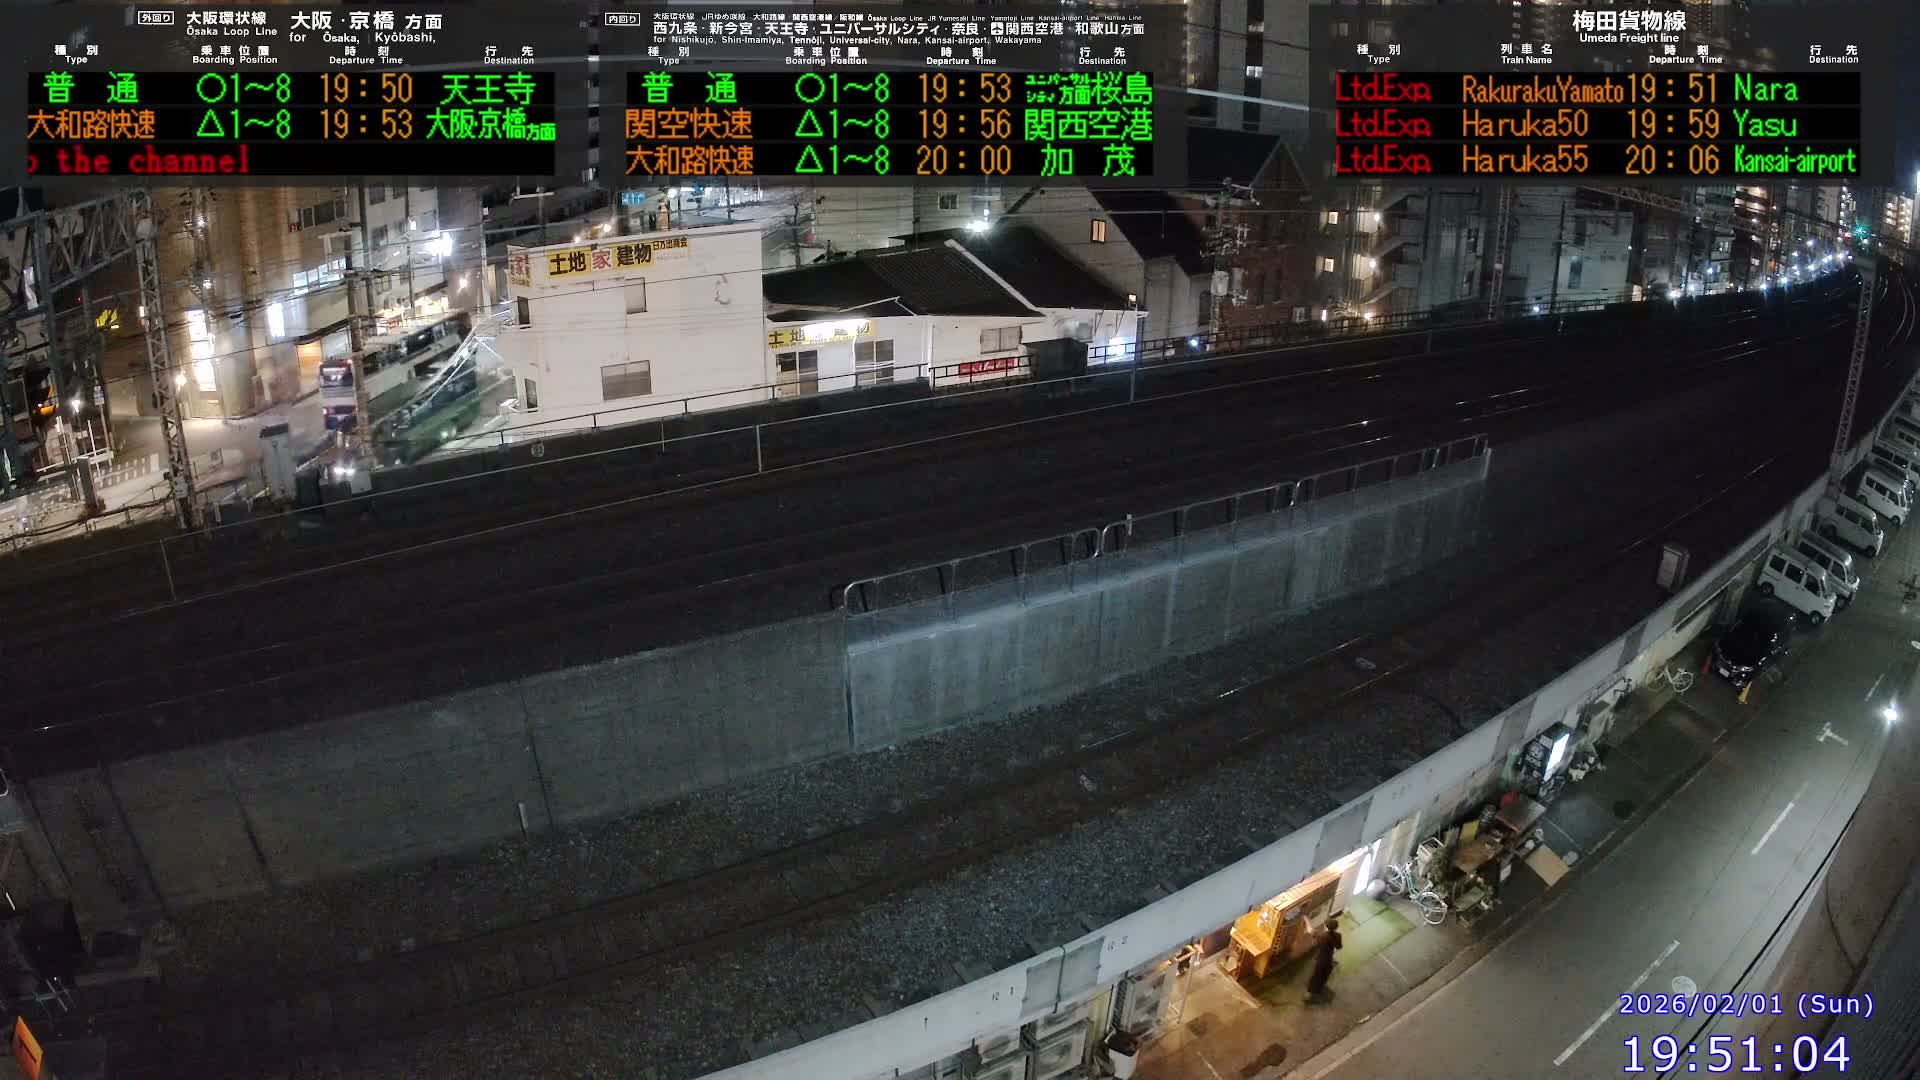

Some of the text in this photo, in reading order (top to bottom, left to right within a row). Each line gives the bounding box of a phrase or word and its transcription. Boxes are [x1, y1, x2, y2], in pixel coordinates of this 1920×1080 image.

[550, 250, 587, 276] 土地
[591, 249, 614, 269] 家
[616, 242, 652, 267] 建物
[768, 328, 805, 345] 土地
